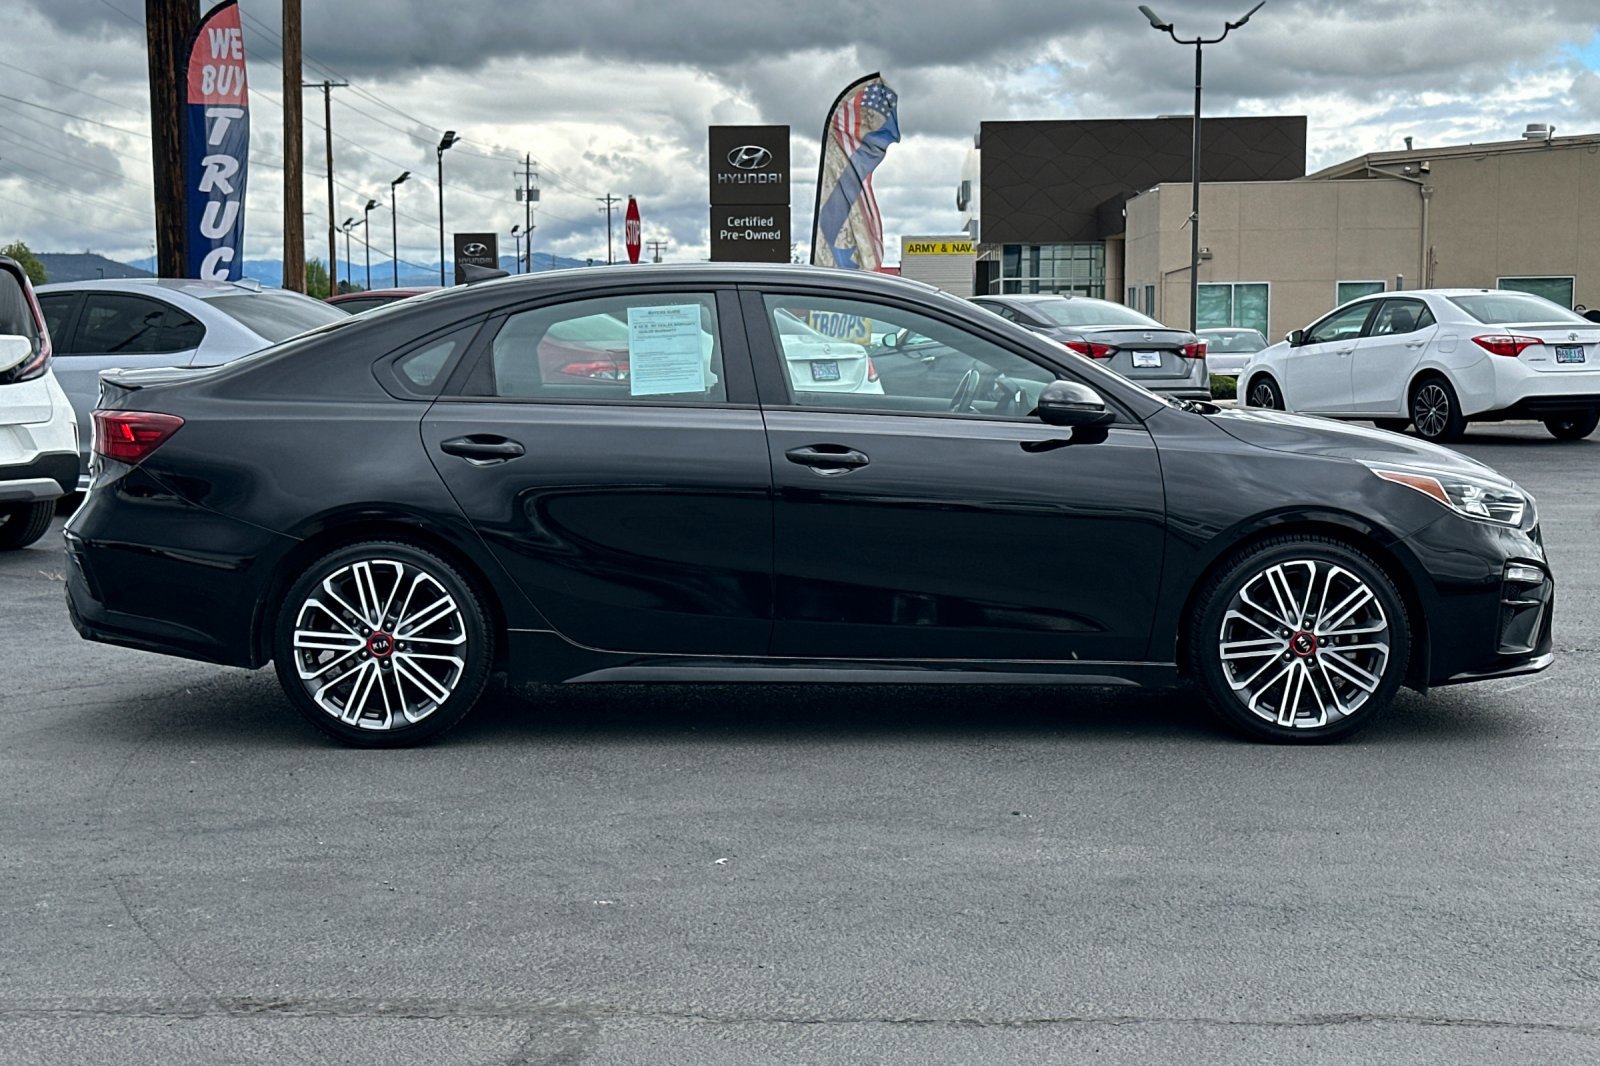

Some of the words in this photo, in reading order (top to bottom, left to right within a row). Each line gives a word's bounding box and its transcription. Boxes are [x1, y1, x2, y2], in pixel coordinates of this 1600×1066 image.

[208, 28, 243, 60] WE
[201, 65, 245, 96] BUY
[718, 173, 782, 184] HYUNDAI
[727, 216, 773, 227] Certified
[627, 220, 640, 246] STOP
[720, 230, 781, 240] Pre-Owned
[908, 243, 936, 252] ARMY
[941, 244, 947, 252] &
[952, 243, 976, 252] NAV
[812, 313, 865, 337] TROOPS
[372, 640, 390, 650] KIA
[1297, 635, 1310, 652] KIA
